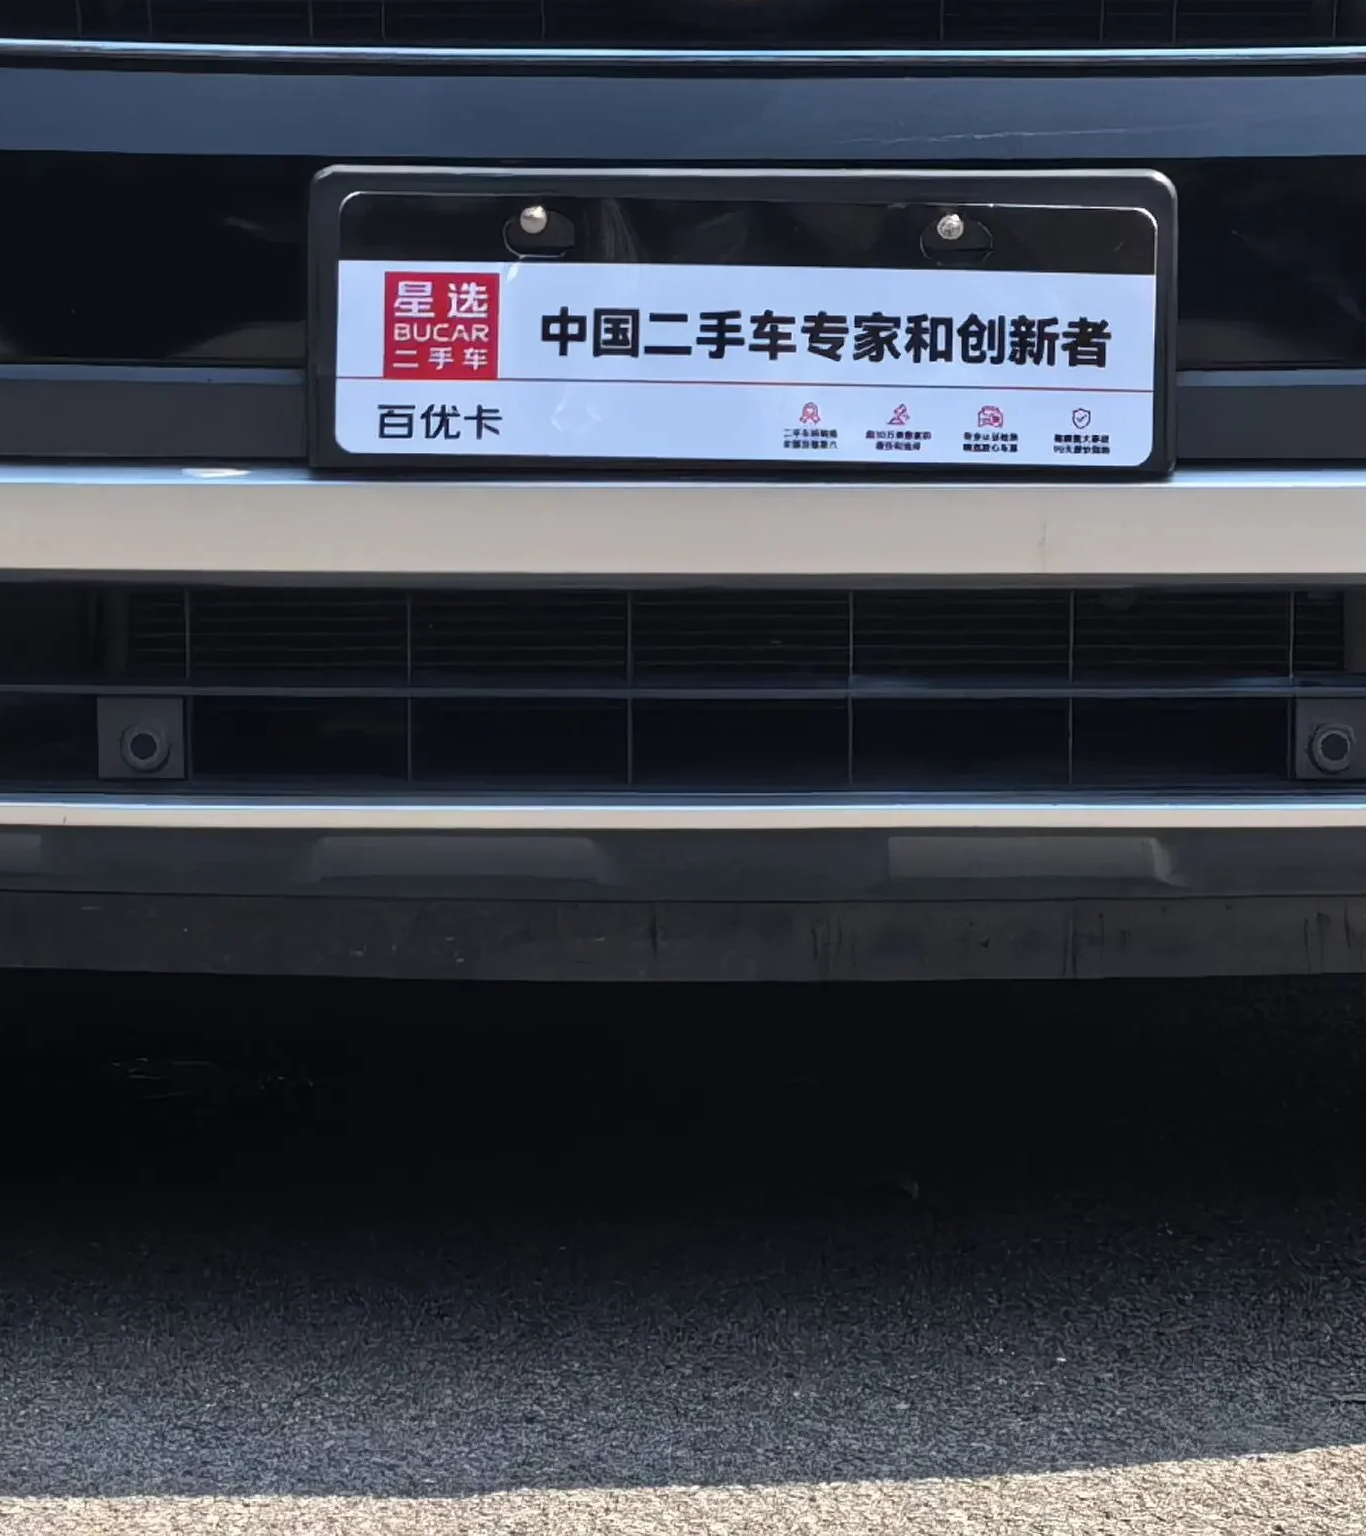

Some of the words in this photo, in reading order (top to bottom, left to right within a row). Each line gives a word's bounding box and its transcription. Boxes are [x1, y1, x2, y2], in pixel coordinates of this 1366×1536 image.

[393, 280, 488, 319] 星选
[393, 323, 490, 342] BUCAR
[541, 305, 1112, 368] 中国二手车专家和创新者
[392, 346, 489, 371] 二手车
[377, 403, 503, 441] 百优卡
